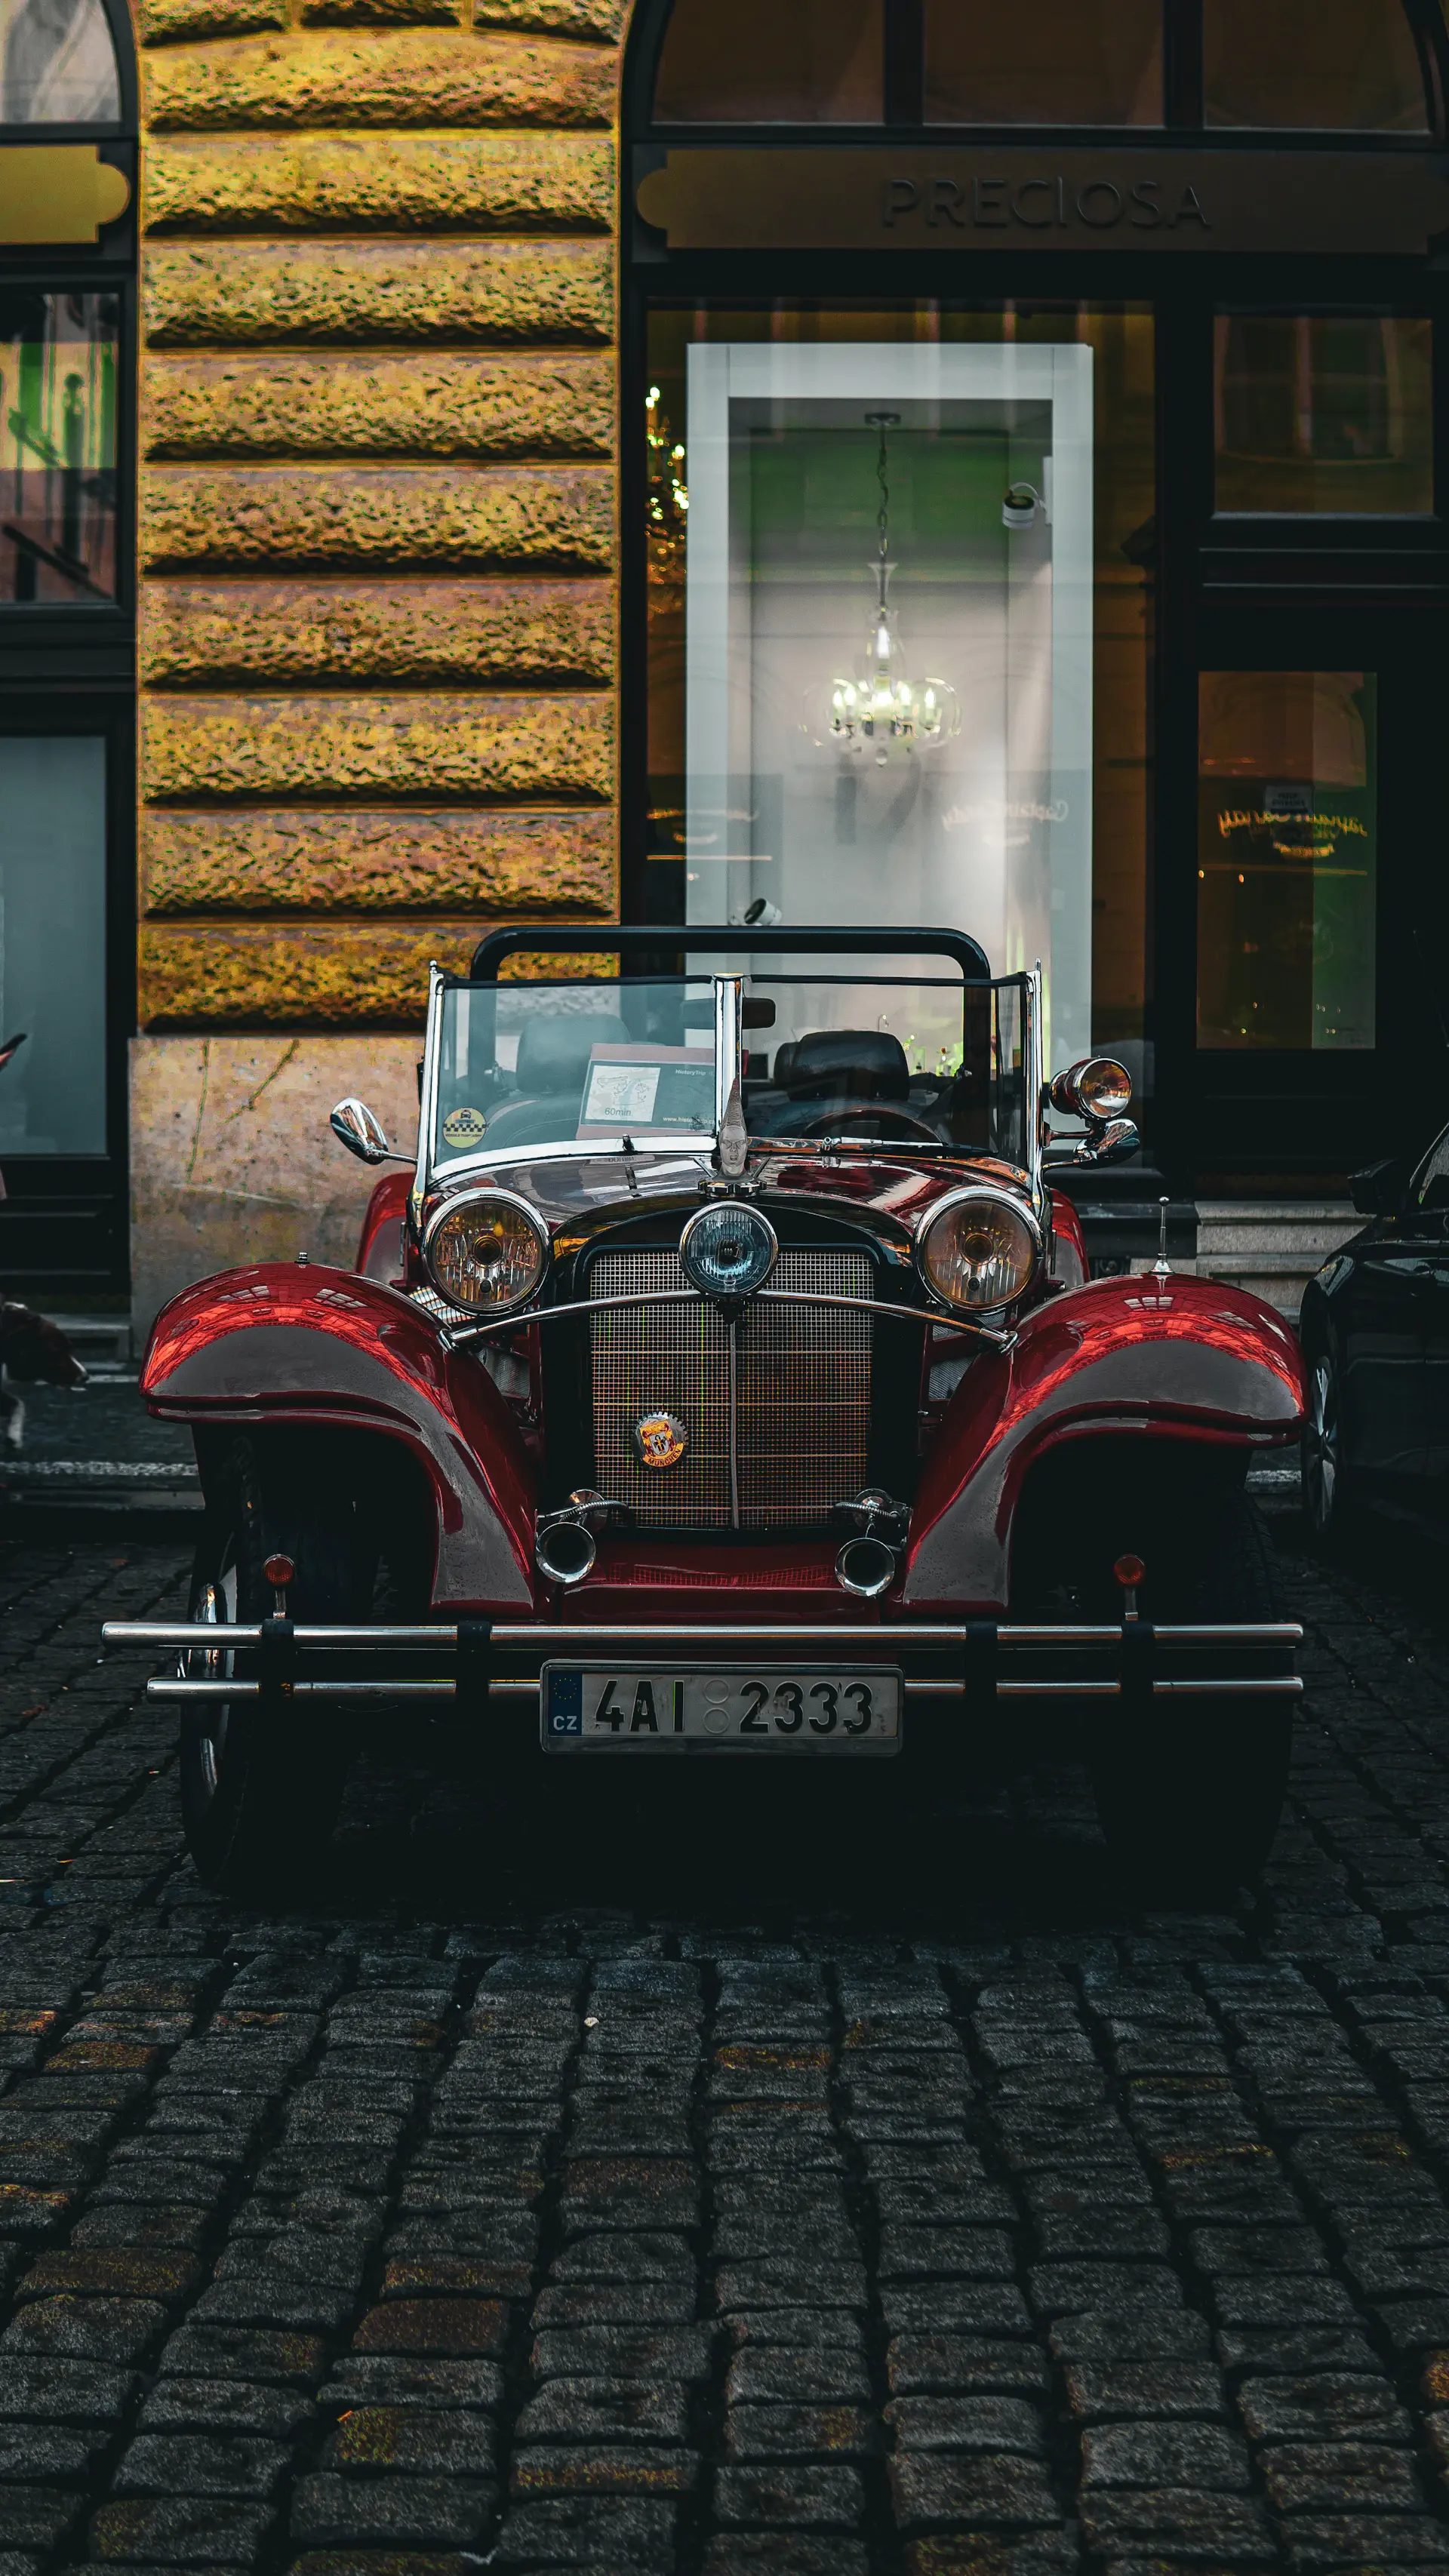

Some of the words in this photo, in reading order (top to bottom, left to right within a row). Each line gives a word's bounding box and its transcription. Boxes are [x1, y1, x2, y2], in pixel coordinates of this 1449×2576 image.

[883, 177, 1212, 229] PRECIOSA
[675, 1068, 706, 1077] HistoryTrip
[605, 1107, 634, 1117] 60min.
[740, 1681, 874, 1734] 2333
[553, 1714, 577, 1731] CZ
